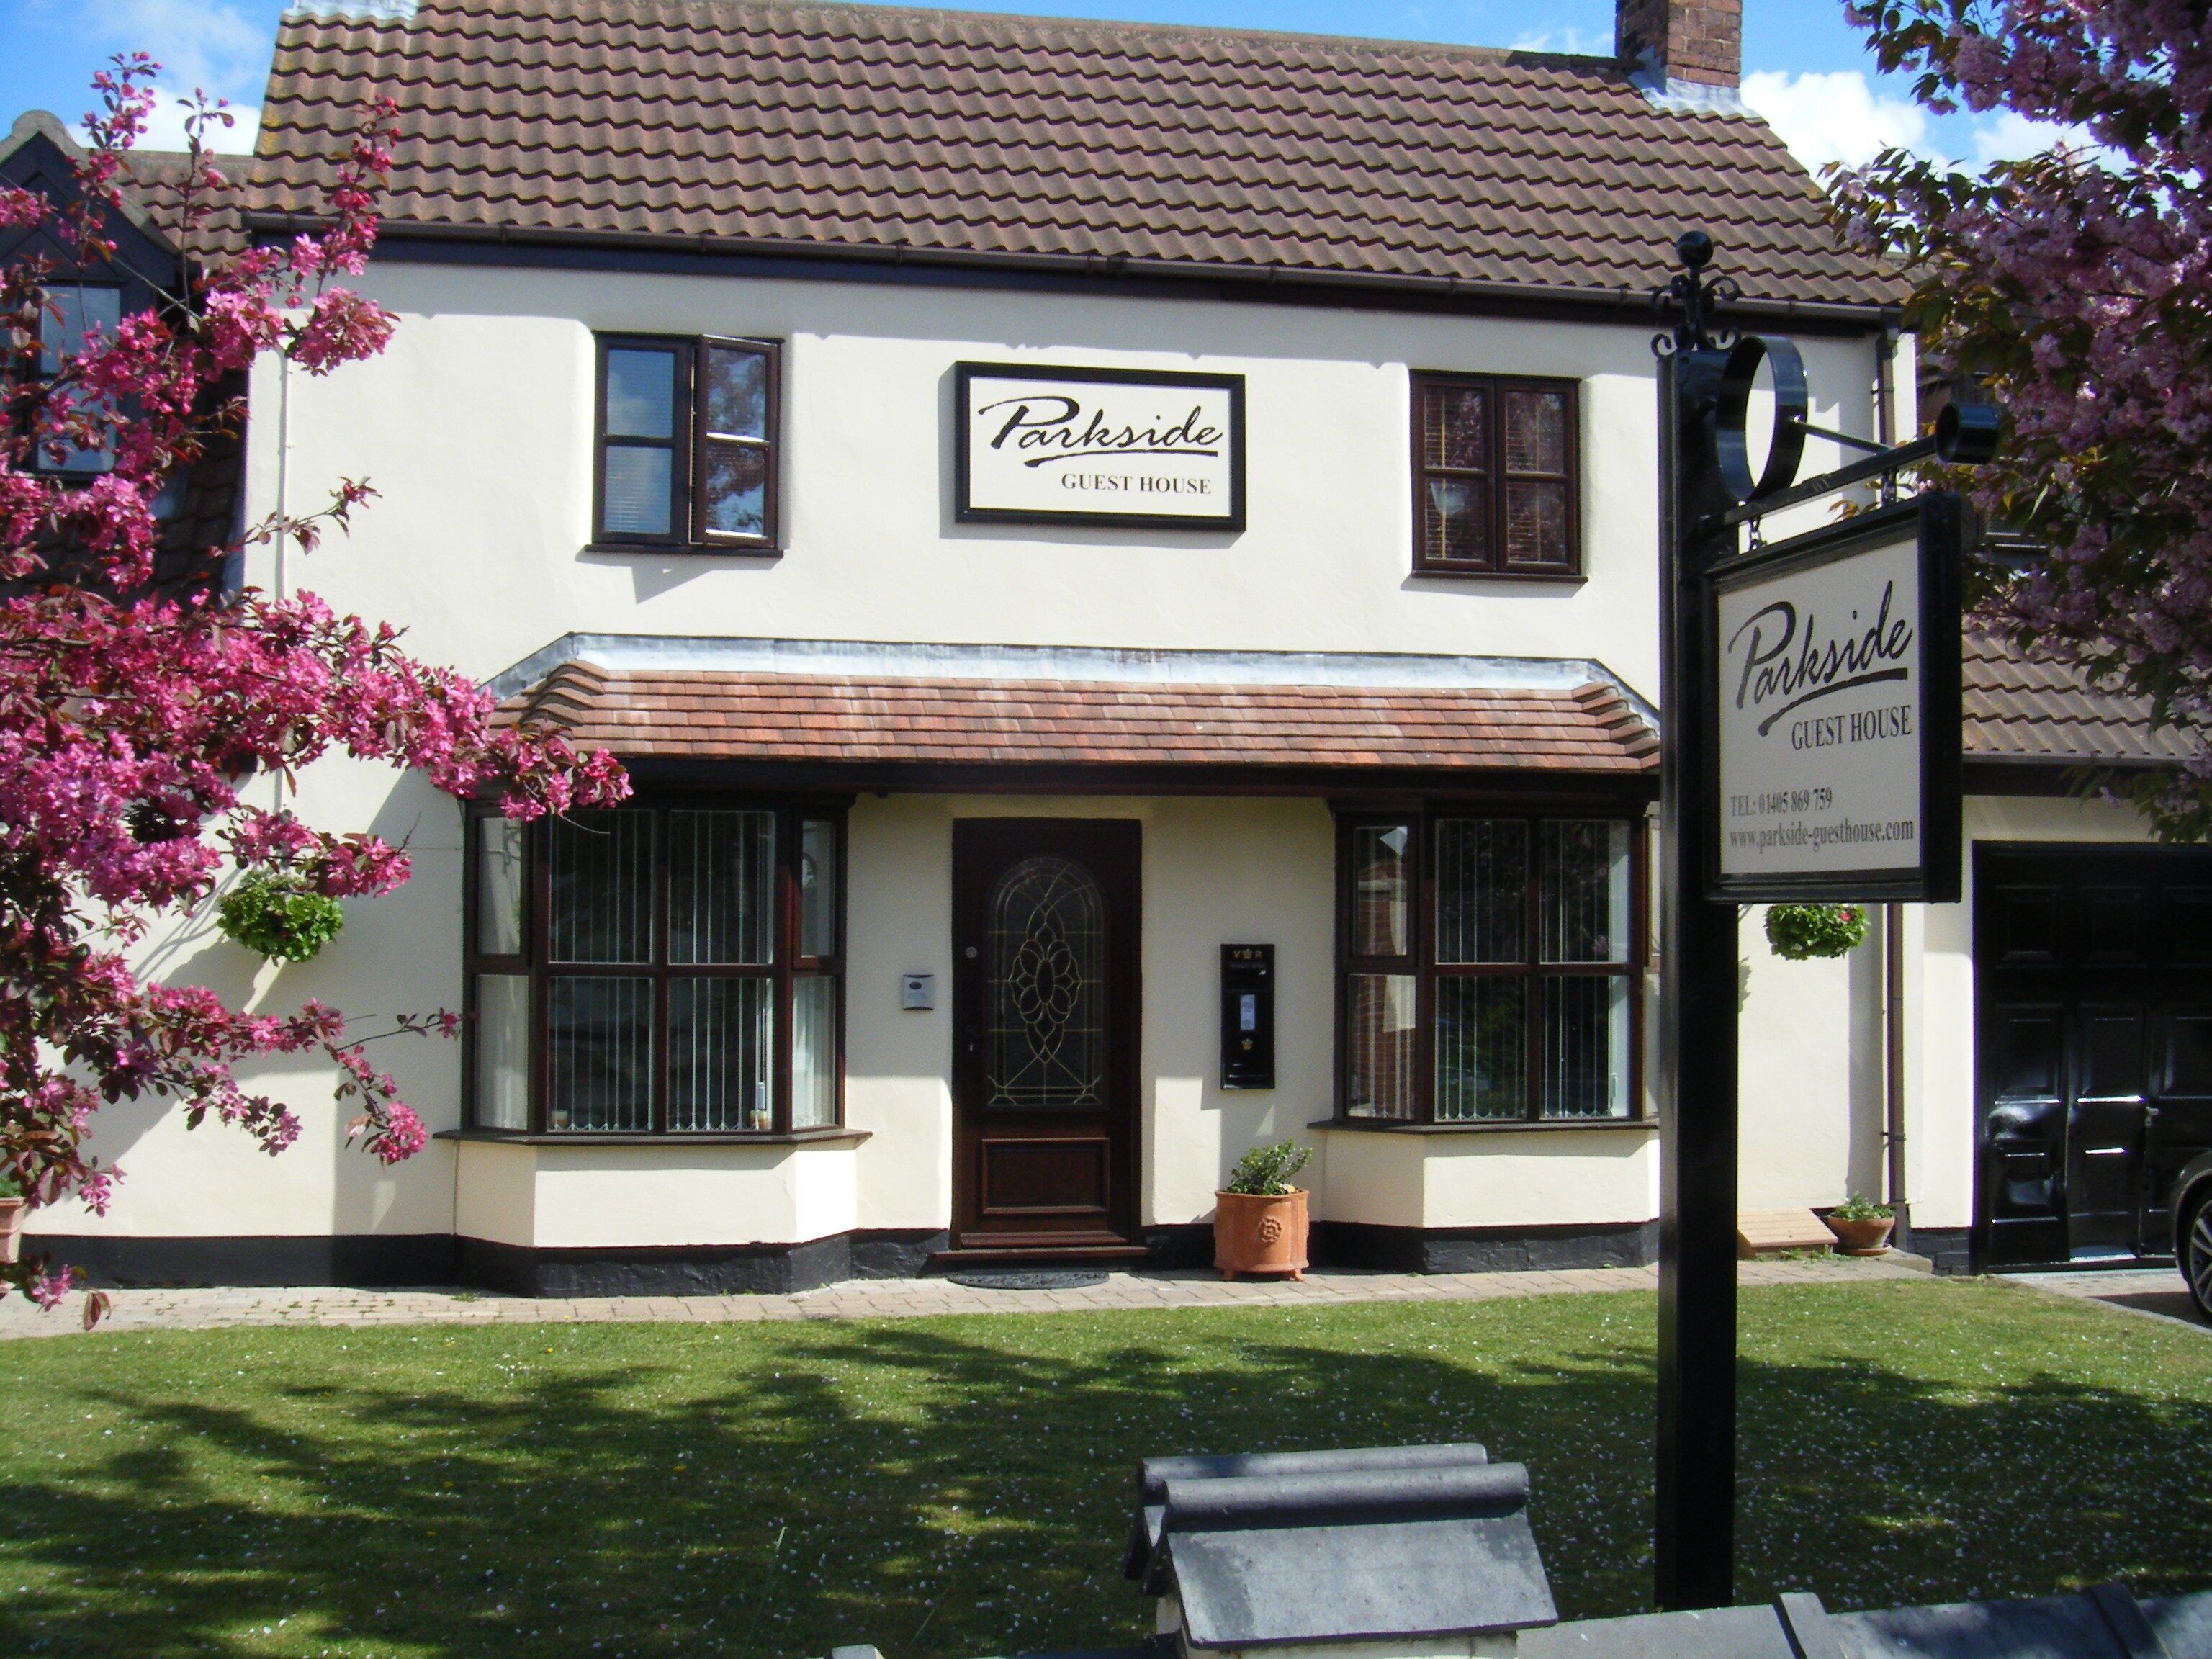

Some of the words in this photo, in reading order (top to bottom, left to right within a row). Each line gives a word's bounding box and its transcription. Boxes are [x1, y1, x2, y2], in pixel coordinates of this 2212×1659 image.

[978, 395, 1223, 450] Parkside
[1061, 472, 1134, 492] GUEST
[1139, 476, 1212, 495] HOUSE
[1728, 580, 1913, 711] Parkside
[1791, 714, 1845, 750] GUEST
[1851, 705, 1912, 742] HOUSE
[1730, 795, 1757, 817] TEL:
[1758, 791, 1789, 815] 01405
[1791, 789, 1810, 812] 869
[1813, 787, 1833, 810] 759
[1730, 817, 1914, 854] www.parkside-guesthouse.com
